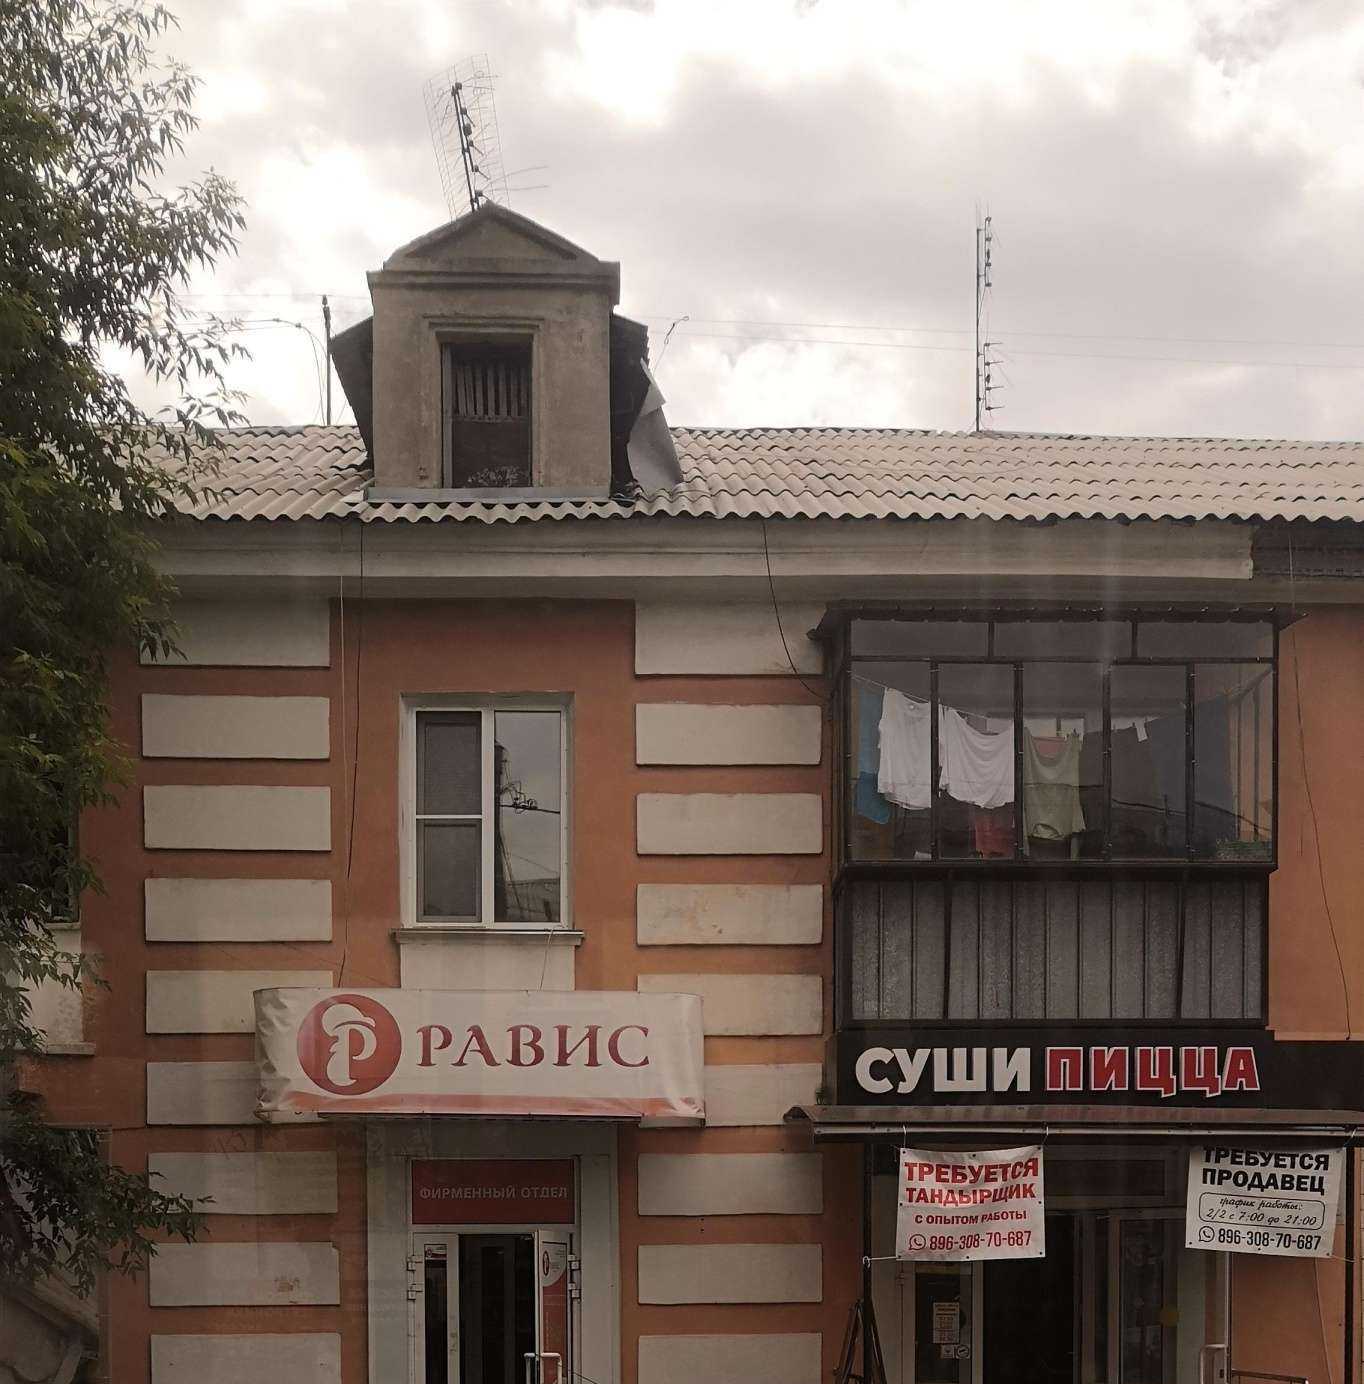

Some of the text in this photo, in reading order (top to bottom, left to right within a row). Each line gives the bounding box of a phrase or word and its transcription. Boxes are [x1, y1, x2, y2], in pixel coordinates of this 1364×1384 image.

[416, 1023, 650, 1068] РАВИС
[855, 1046, 1261, 1098] СУШИ ПИЦЦА
[1202, 1147, 1329, 1171] ТРЕБУЕТСЯ
[904, 1158, 1039, 1184] ТРЕБУЕТСЯ
[1202, 1168, 1325, 1196] ПРОДАВЕЦ
[419, 1184, 568, 1199] ФИРМЕННЫЙ ОТДЕЛ
[906, 1183, 1036, 1206] ТАНДЫРЩИК
[926, 1214, 979, 1225] ОПЫТОМ
[981, 1210, 1027, 1223] РАБОТЫ
[1206, 1208, 1226, 1220] 2/2
[1239, 1211, 1265, 1222] 7:00
[1283, 1214, 1317, 1226] 21:00
[929, 1231, 1032, 1251] 896-308-70-687
[1218, 1228, 1321, 1251] 896-308-70-687
